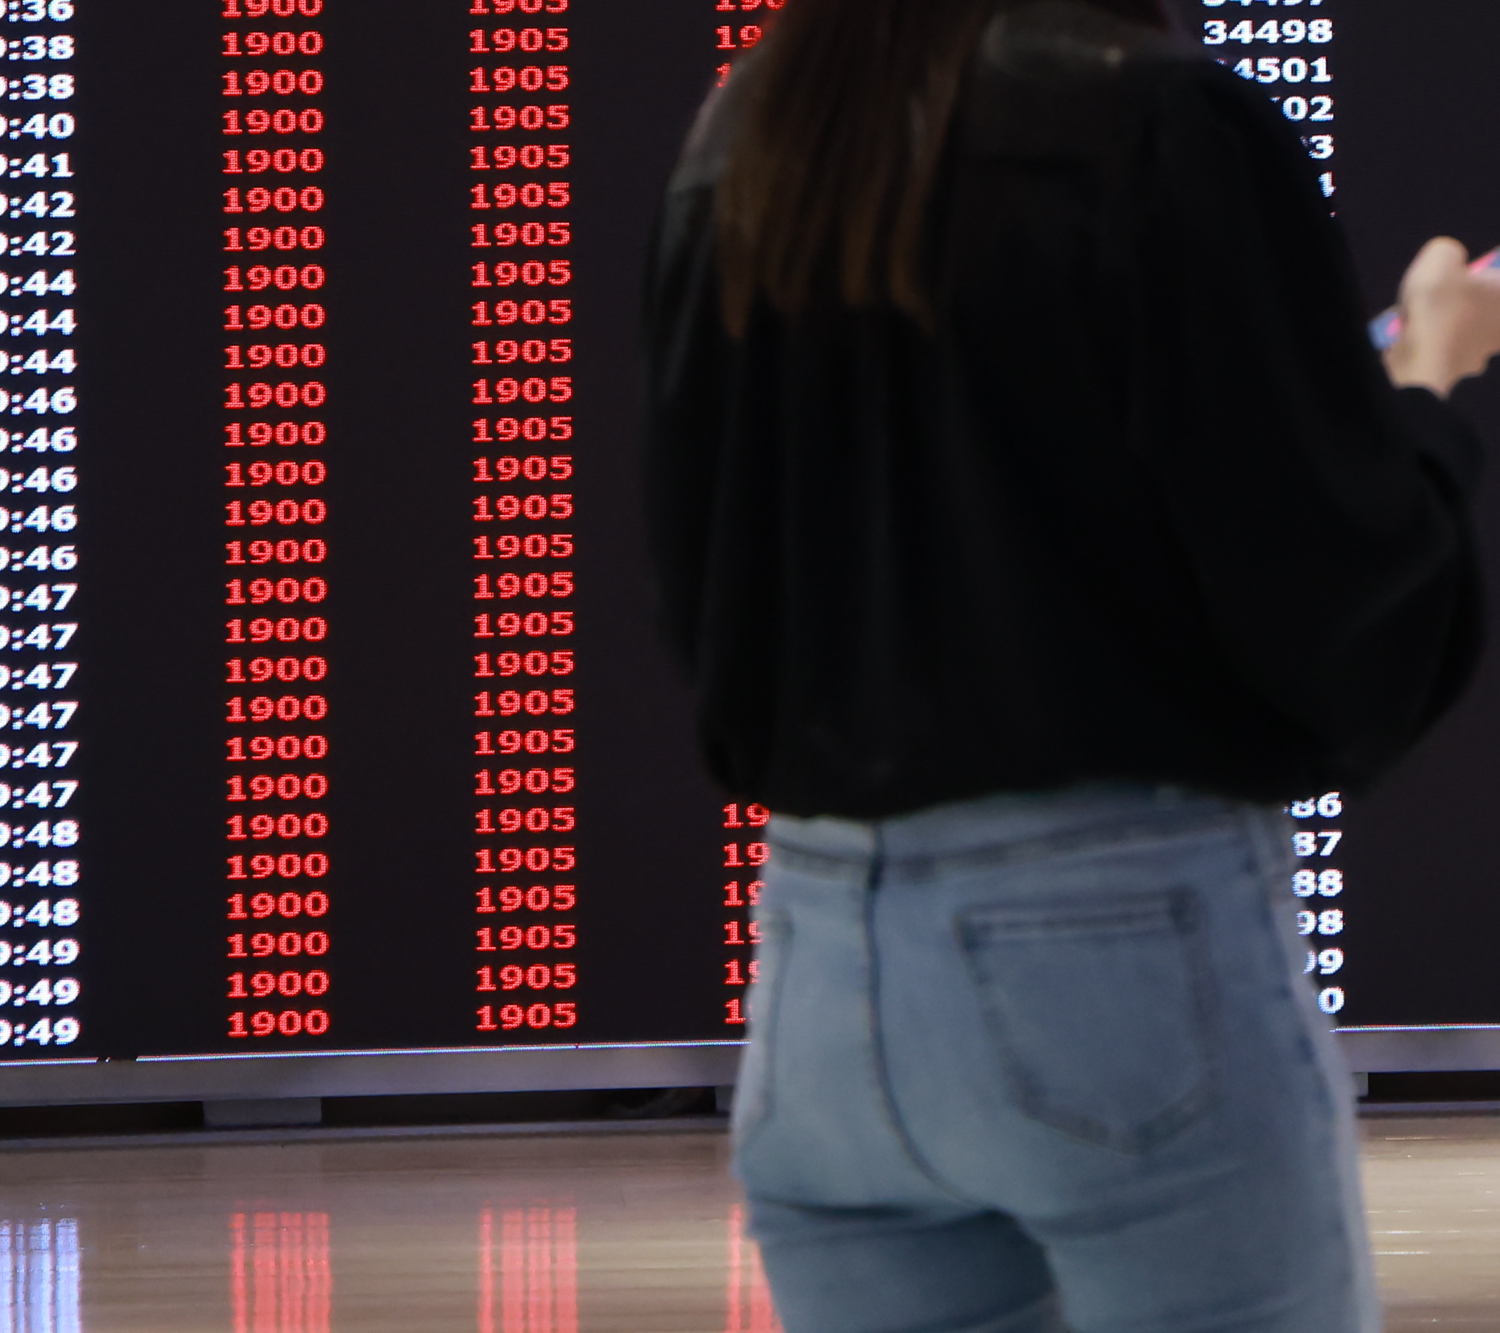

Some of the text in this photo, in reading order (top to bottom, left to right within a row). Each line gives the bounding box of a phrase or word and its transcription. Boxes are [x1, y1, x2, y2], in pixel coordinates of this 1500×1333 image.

[226, 695, 328, 723] 1900
[474, 689, 575, 717] 1905
[228, 1009, 330, 1037] 1900
[476, 1003, 577, 1031] 1905
